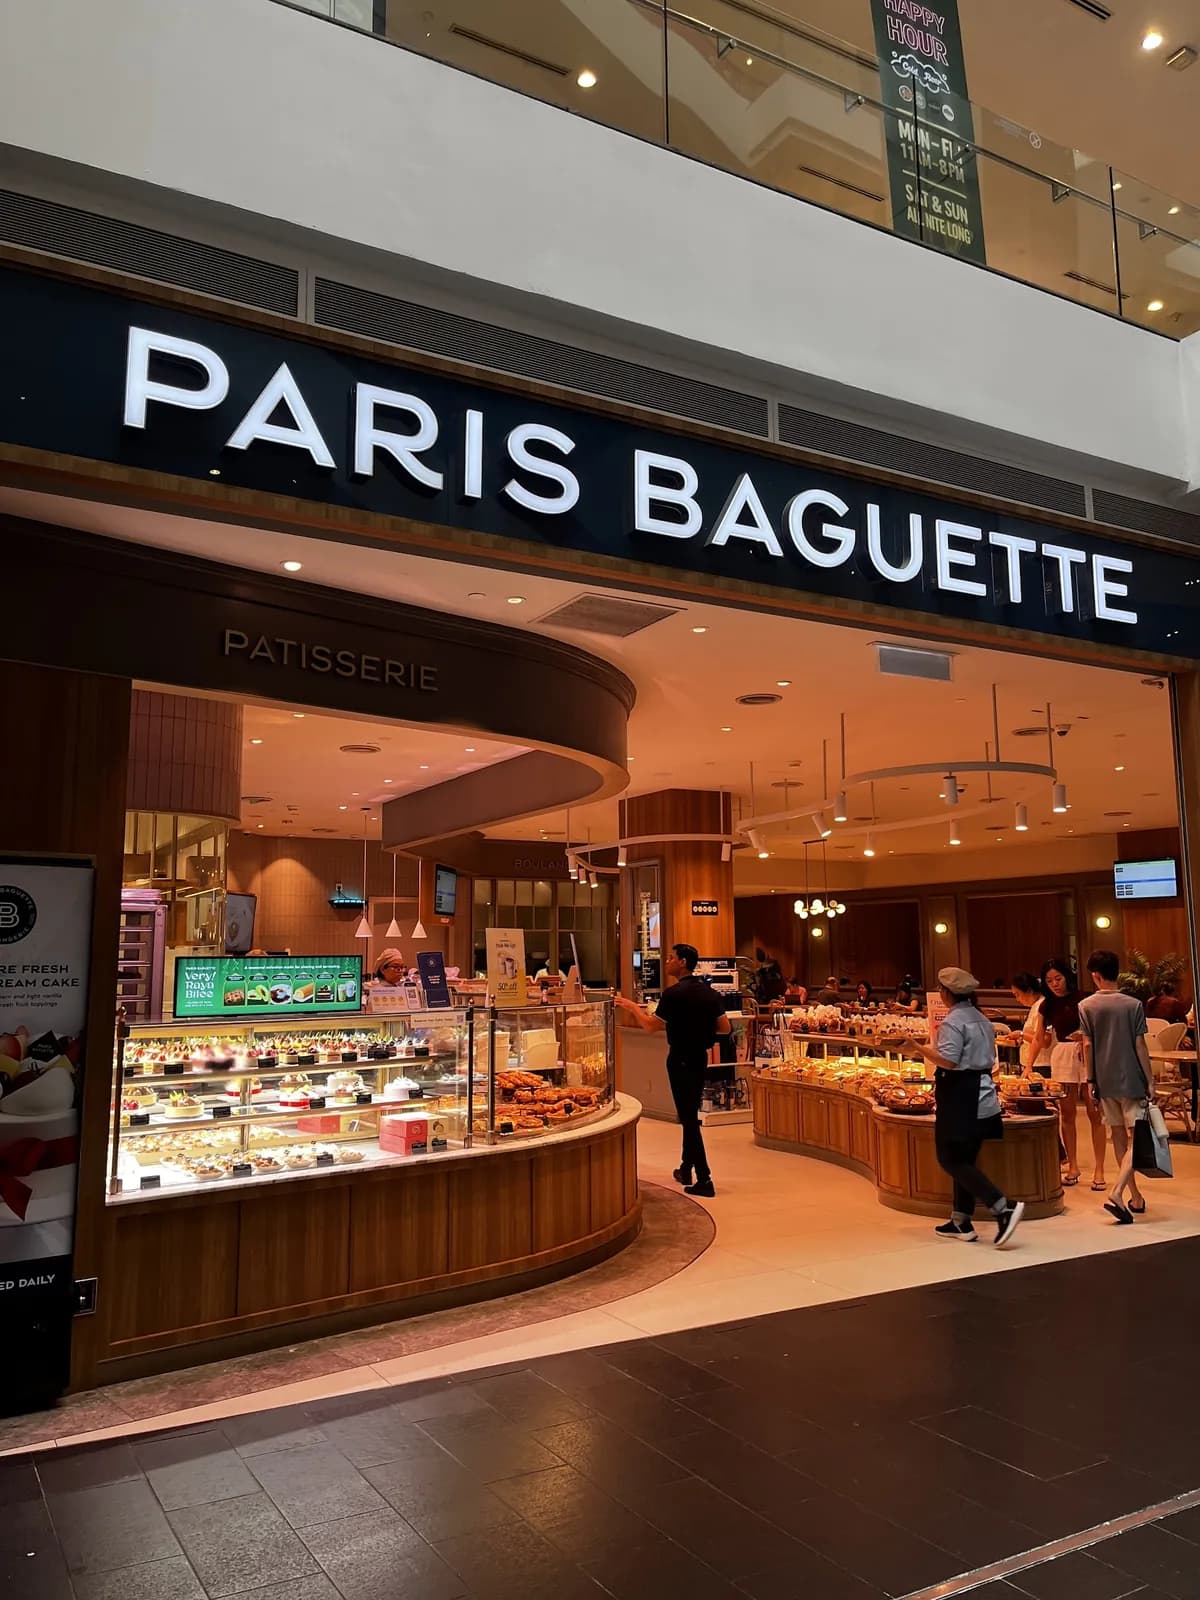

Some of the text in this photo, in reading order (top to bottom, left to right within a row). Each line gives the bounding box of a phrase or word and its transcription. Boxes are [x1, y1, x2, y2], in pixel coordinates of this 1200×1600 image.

[886, 14, 949, 67] HOUR
[932, 195, 942, 214] &
[944, 200, 969, 225] SUN
[925, 213, 946, 236] NITE
[946, 222, 972, 245] LONG
[123, 326, 1137, 624] PARIS BAGUETTE
[224, 628, 439, 692] PATISSERIE
[21, 964, 69, 974] FRESH
[41, 977, 80, 987] CAKE
[0, 1273, 56, 1290] ED DAILY
